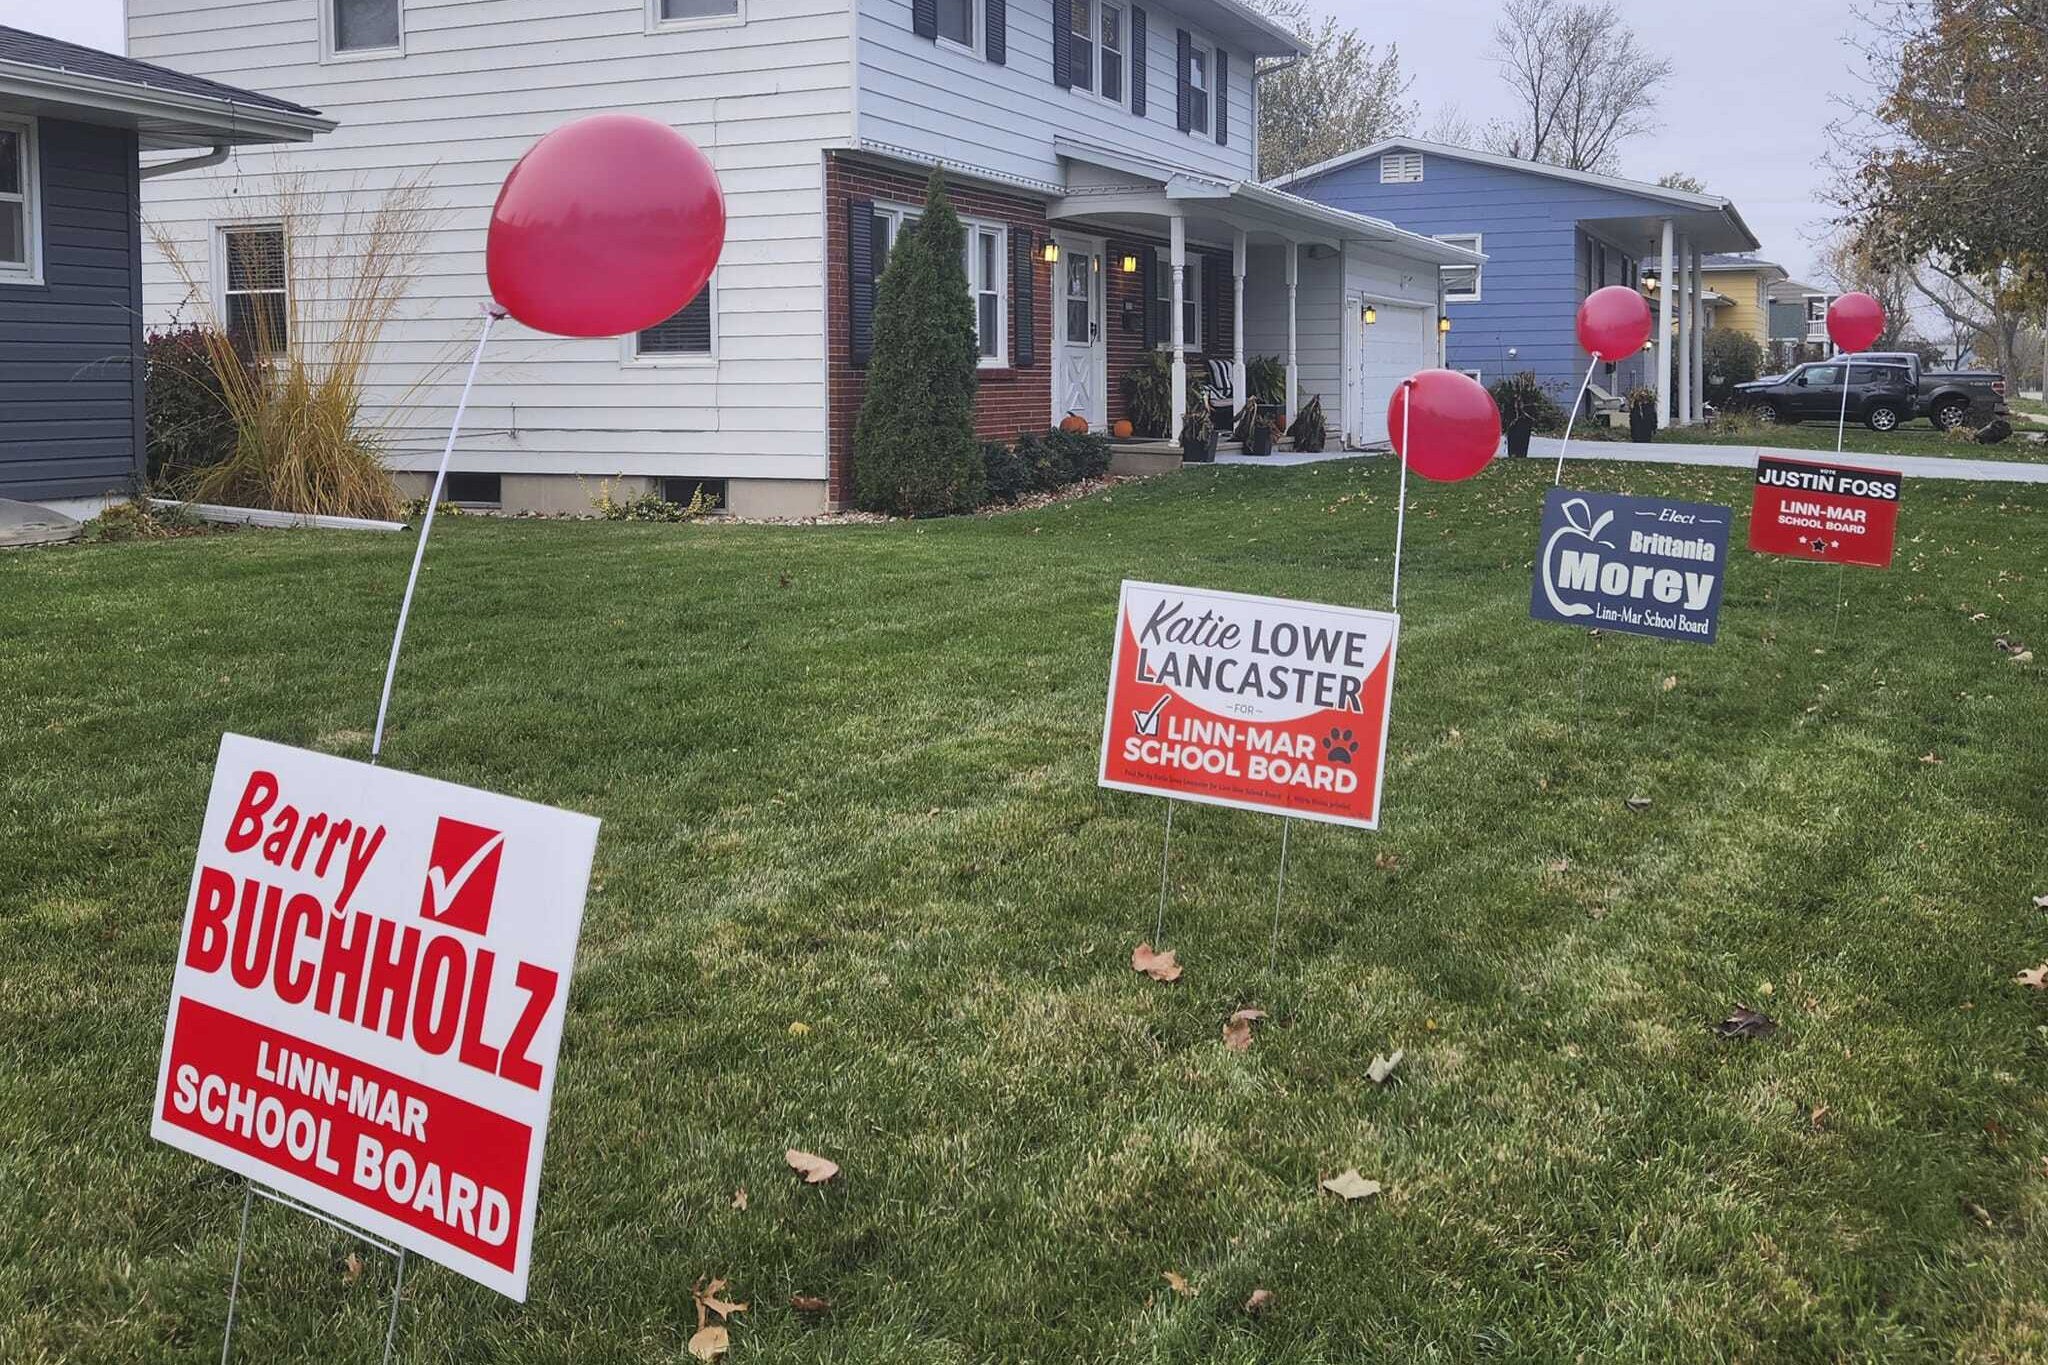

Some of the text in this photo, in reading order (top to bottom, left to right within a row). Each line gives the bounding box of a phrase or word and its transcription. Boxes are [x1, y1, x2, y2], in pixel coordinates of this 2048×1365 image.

[1758, 469, 1896, 499] JUSTIN FOSS
[1780, 500, 1866, 523] LINN-MAR
[1658, 508, 1696, 524] Elect
[1778, 515, 1865, 534] SCHOOL BOARD
[1629, 530, 1716, 562] Brittania
[1557, 550, 1714, 611] Morey
[1139, 599, 1367, 668] Katie LOWE
[1596, 602, 1709, 634] Linn-Mar School Board
[1136, 647, 1363, 713] LANCASTER
[1123, 737, 1241, 777] SCHOOL
[1248, 755, 1358, 794] BOARD
[1168, 716, 1316, 760] LINN-MAR
[224, 770, 387, 913] Barry
[184, 865, 559, 1092] BUCHHOLZ
[256, 1041, 427, 1143] LINN-MAR
[173, 1063, 511, 1248] SCHOOL BOARD
